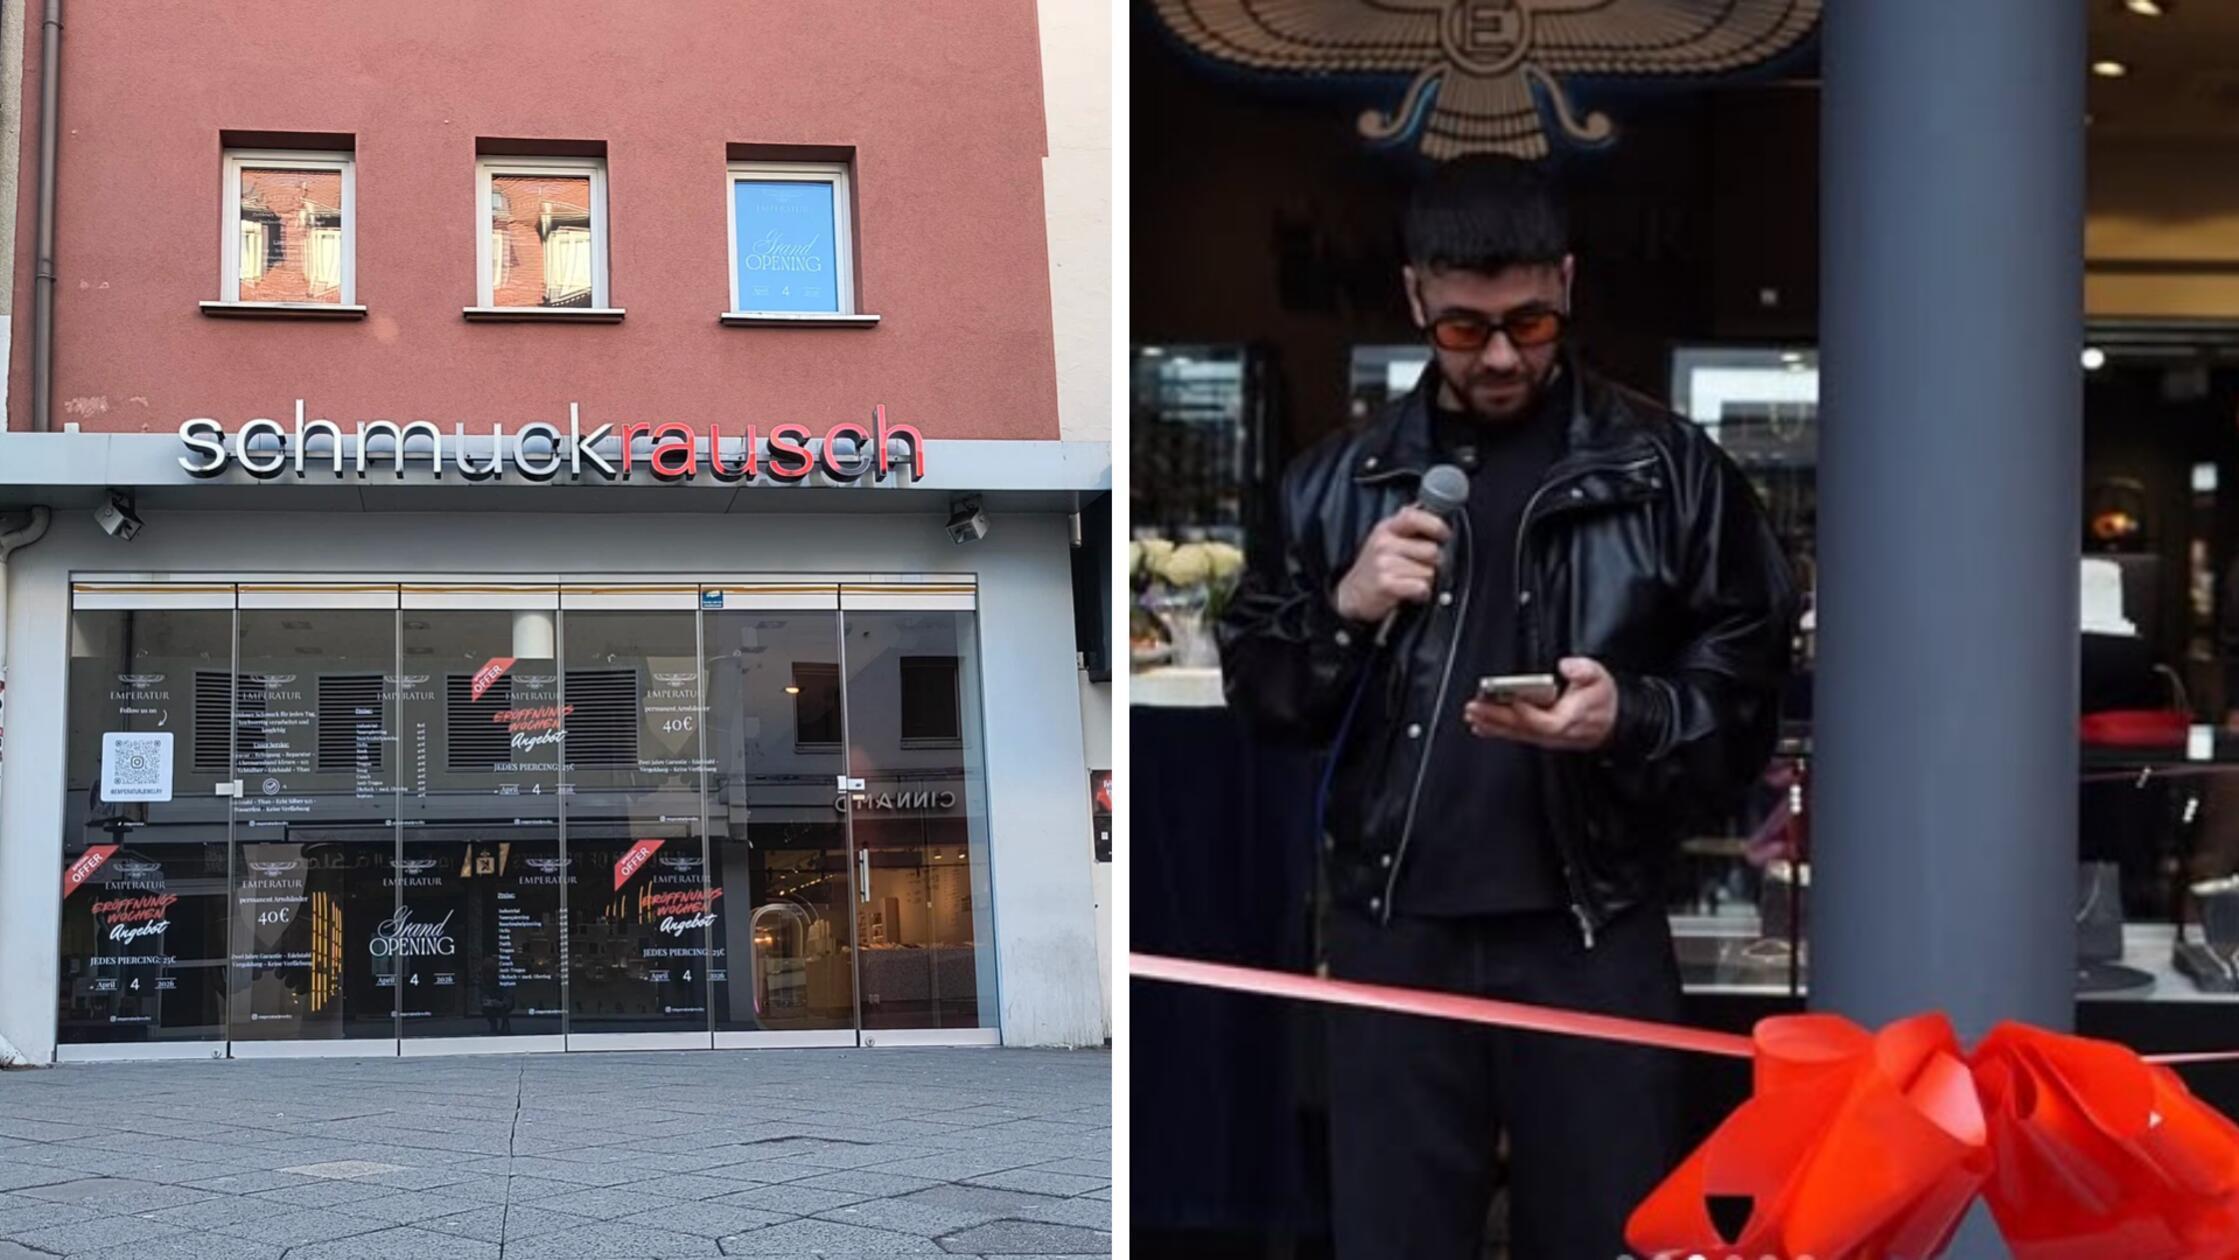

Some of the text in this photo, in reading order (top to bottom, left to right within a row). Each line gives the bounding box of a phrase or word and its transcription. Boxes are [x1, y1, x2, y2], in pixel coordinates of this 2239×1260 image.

[752, 229, 820, 255] Grand
[745, 254, 821, 272] OPENING
[177, 399, 926, 480] schmuckrausch
[473, 665, 502, 693] OFFER
[110, 691, 170, 700] EMPERATUR
[662, 716, 693, 733] 40€
[511, 728, 567, 752] Angebot
[494, 763, 518, 772] JEDES
[532, 783, 541, 795] 4
[72, 853, 103, 882] OFFER
[621, 847, 650, 876] OFFER
[105, 880, 166, 890] EMPERATUR
[242, 879, 303, 889] EMPERATUR
[107, 907, 165, 924] WOCHEN
[258, 907, 290, 926] 40€
[377, 905, 455, 938] Grand
[109, 919, 171, 945] Angebot
[660, 912, 718, 938] Angebot
[369, 937, 455, 957] OPENING
[643, 947, 668, 958] JEDES
[90, 956, 116, 967] JEDES
[97, 981, 116, 990] April
[130, 978, 140, 990] 4
[410, 973, 419, 986] 4
[682, 969, 692, 982] 4
